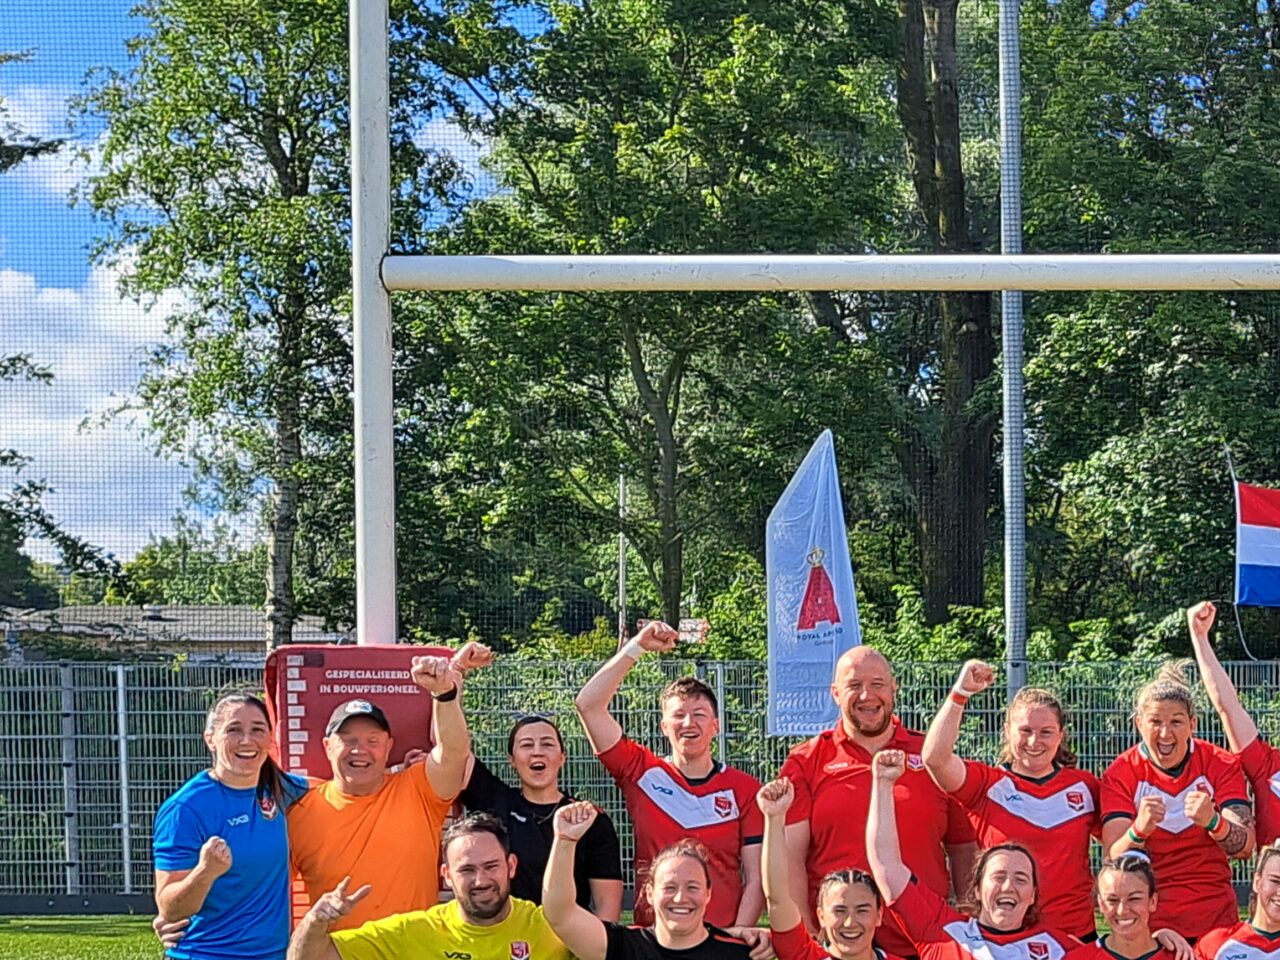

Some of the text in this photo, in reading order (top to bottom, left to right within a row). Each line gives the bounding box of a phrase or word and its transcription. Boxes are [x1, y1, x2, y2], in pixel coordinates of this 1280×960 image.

[325, 670, 410, 679] GESPECIALISEERD
[319, 684, 420, 694] IN BOUWPERSONEEL
